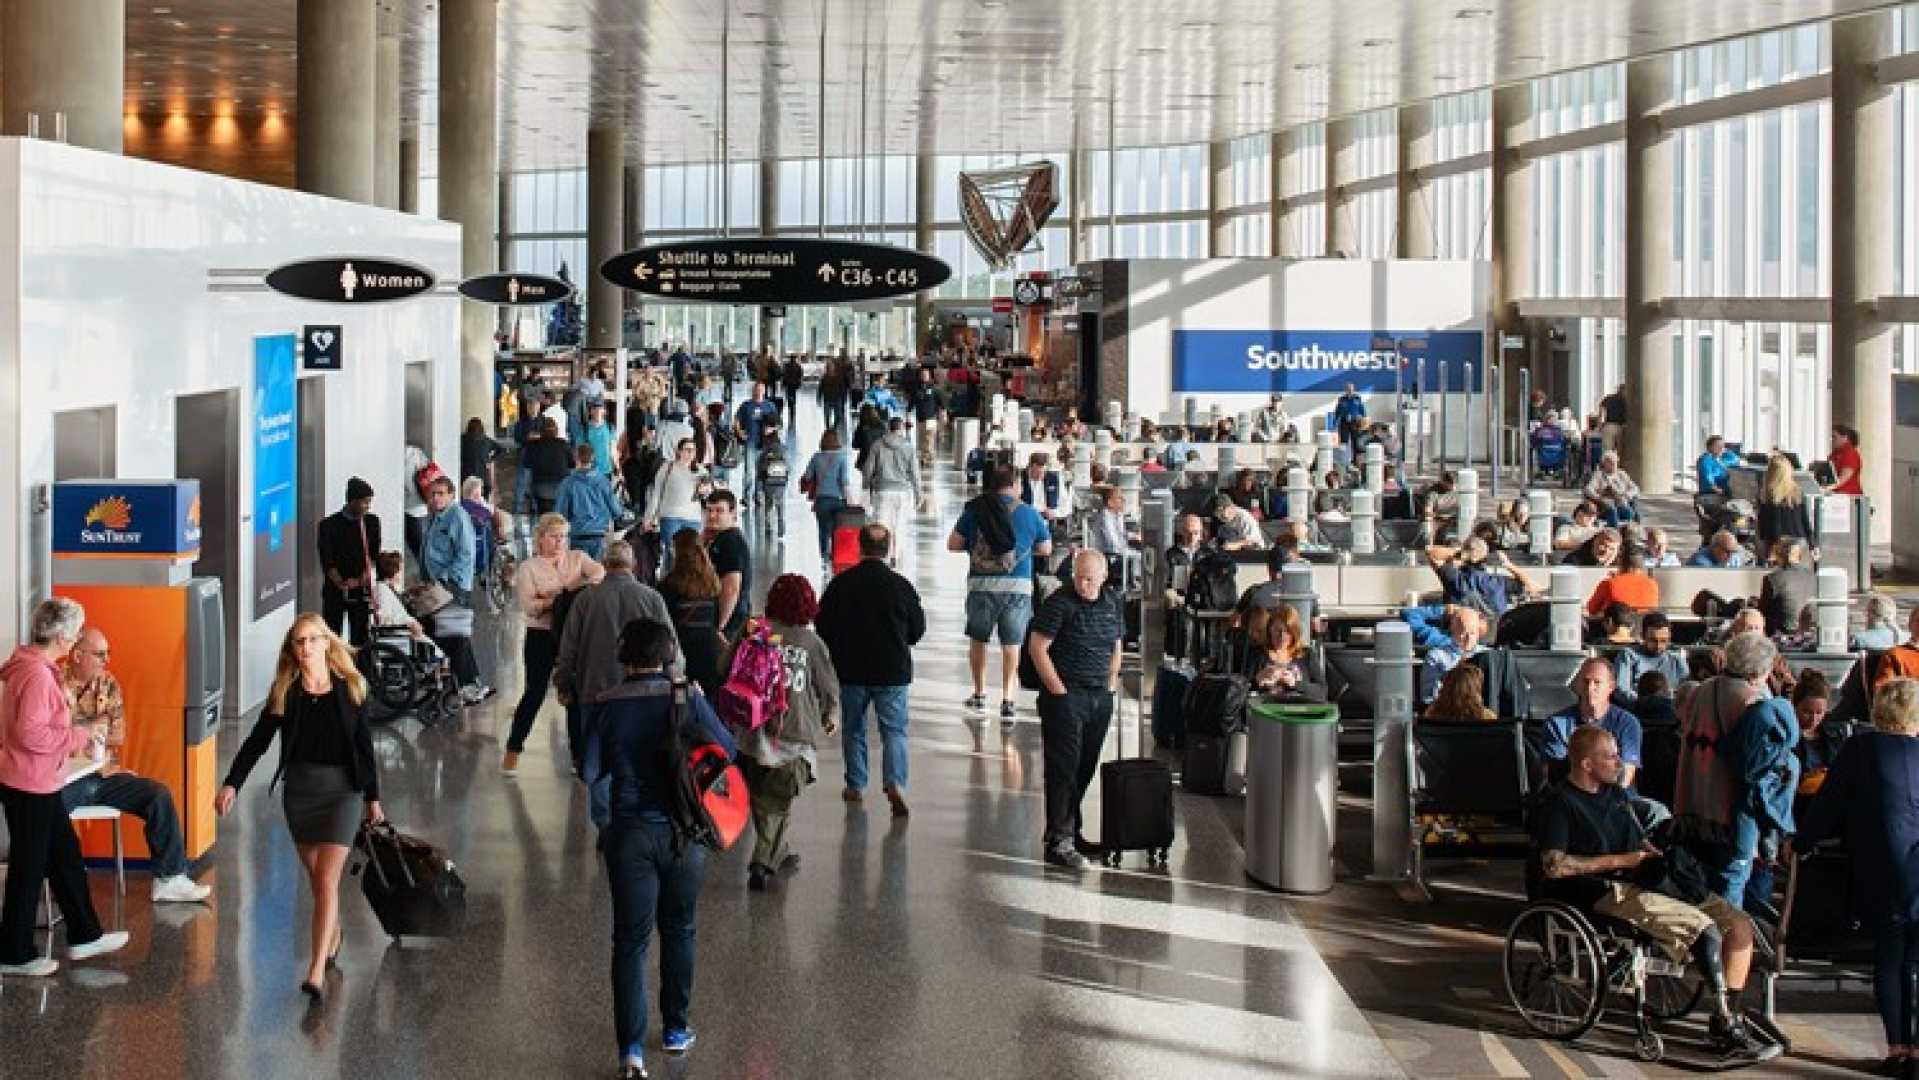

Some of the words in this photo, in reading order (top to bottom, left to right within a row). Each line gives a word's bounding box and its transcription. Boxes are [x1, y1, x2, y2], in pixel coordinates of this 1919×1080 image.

[658, 251, 709, 265] Shuttle
[714, 251, 728, 265] to
[733, 251, 795, 265] Terminal
[362, 273, 424, 288] Women
[841, 268, 873, 286] C36
[886, 268, 918, 286] C45
[1247, 343, 1398, 370] Southwest
